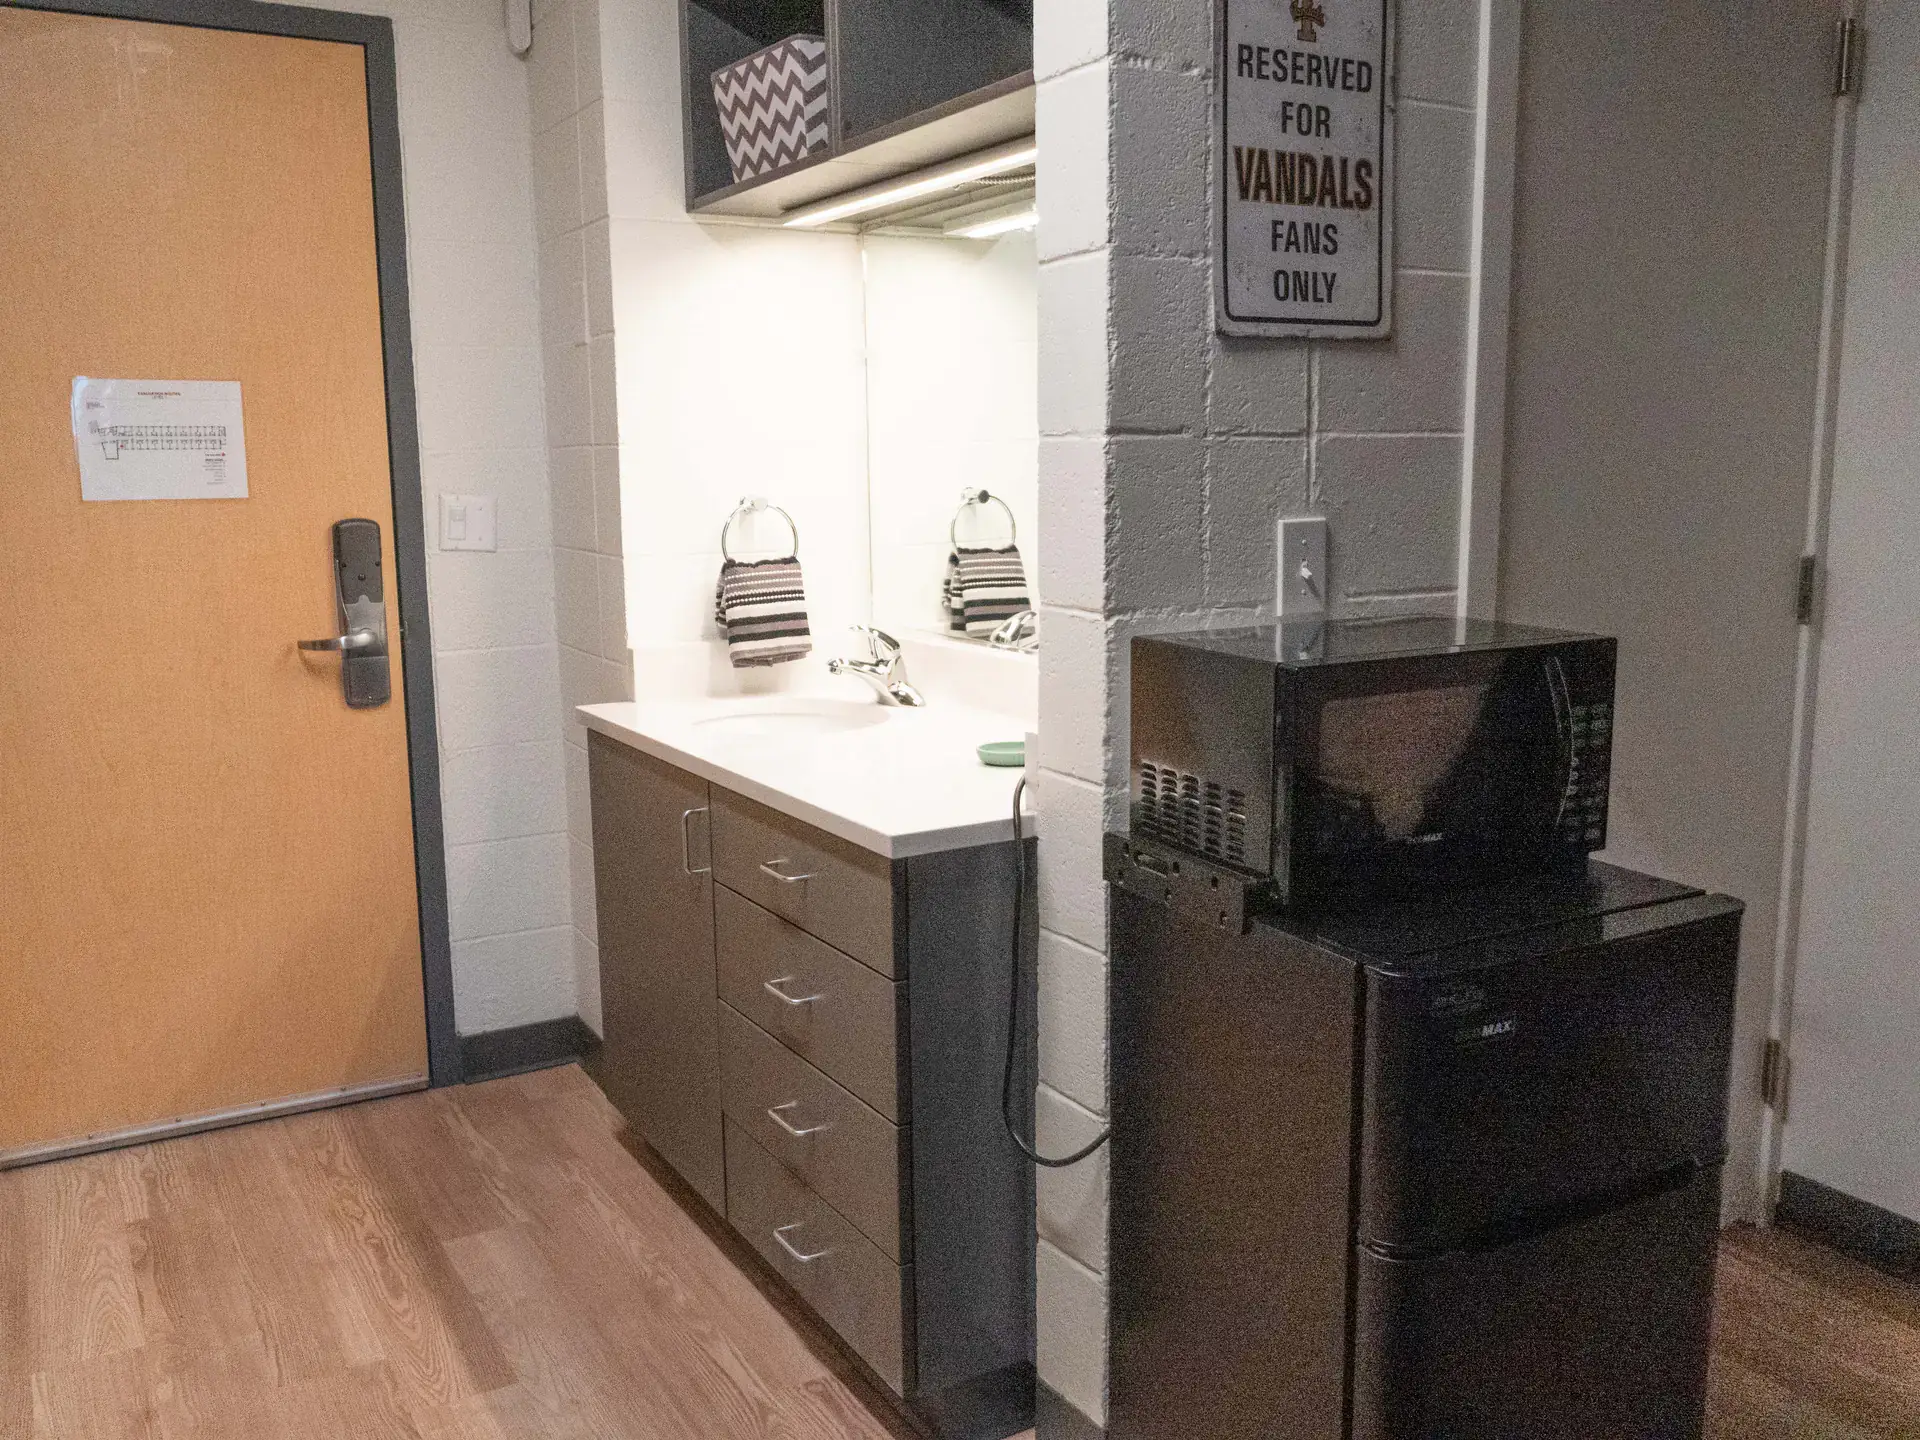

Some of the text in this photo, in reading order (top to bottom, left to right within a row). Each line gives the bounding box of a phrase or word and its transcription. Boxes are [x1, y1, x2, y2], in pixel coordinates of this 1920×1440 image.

[1237, 43, 1373, 93] RESERVED
[1281, 101, 1331, 138] FOR
[1233, 146, 1374, 211] VANDALS
[1271, 219, 1339, 255] FANS
[1273, 269, 1337, 303] ONLY
